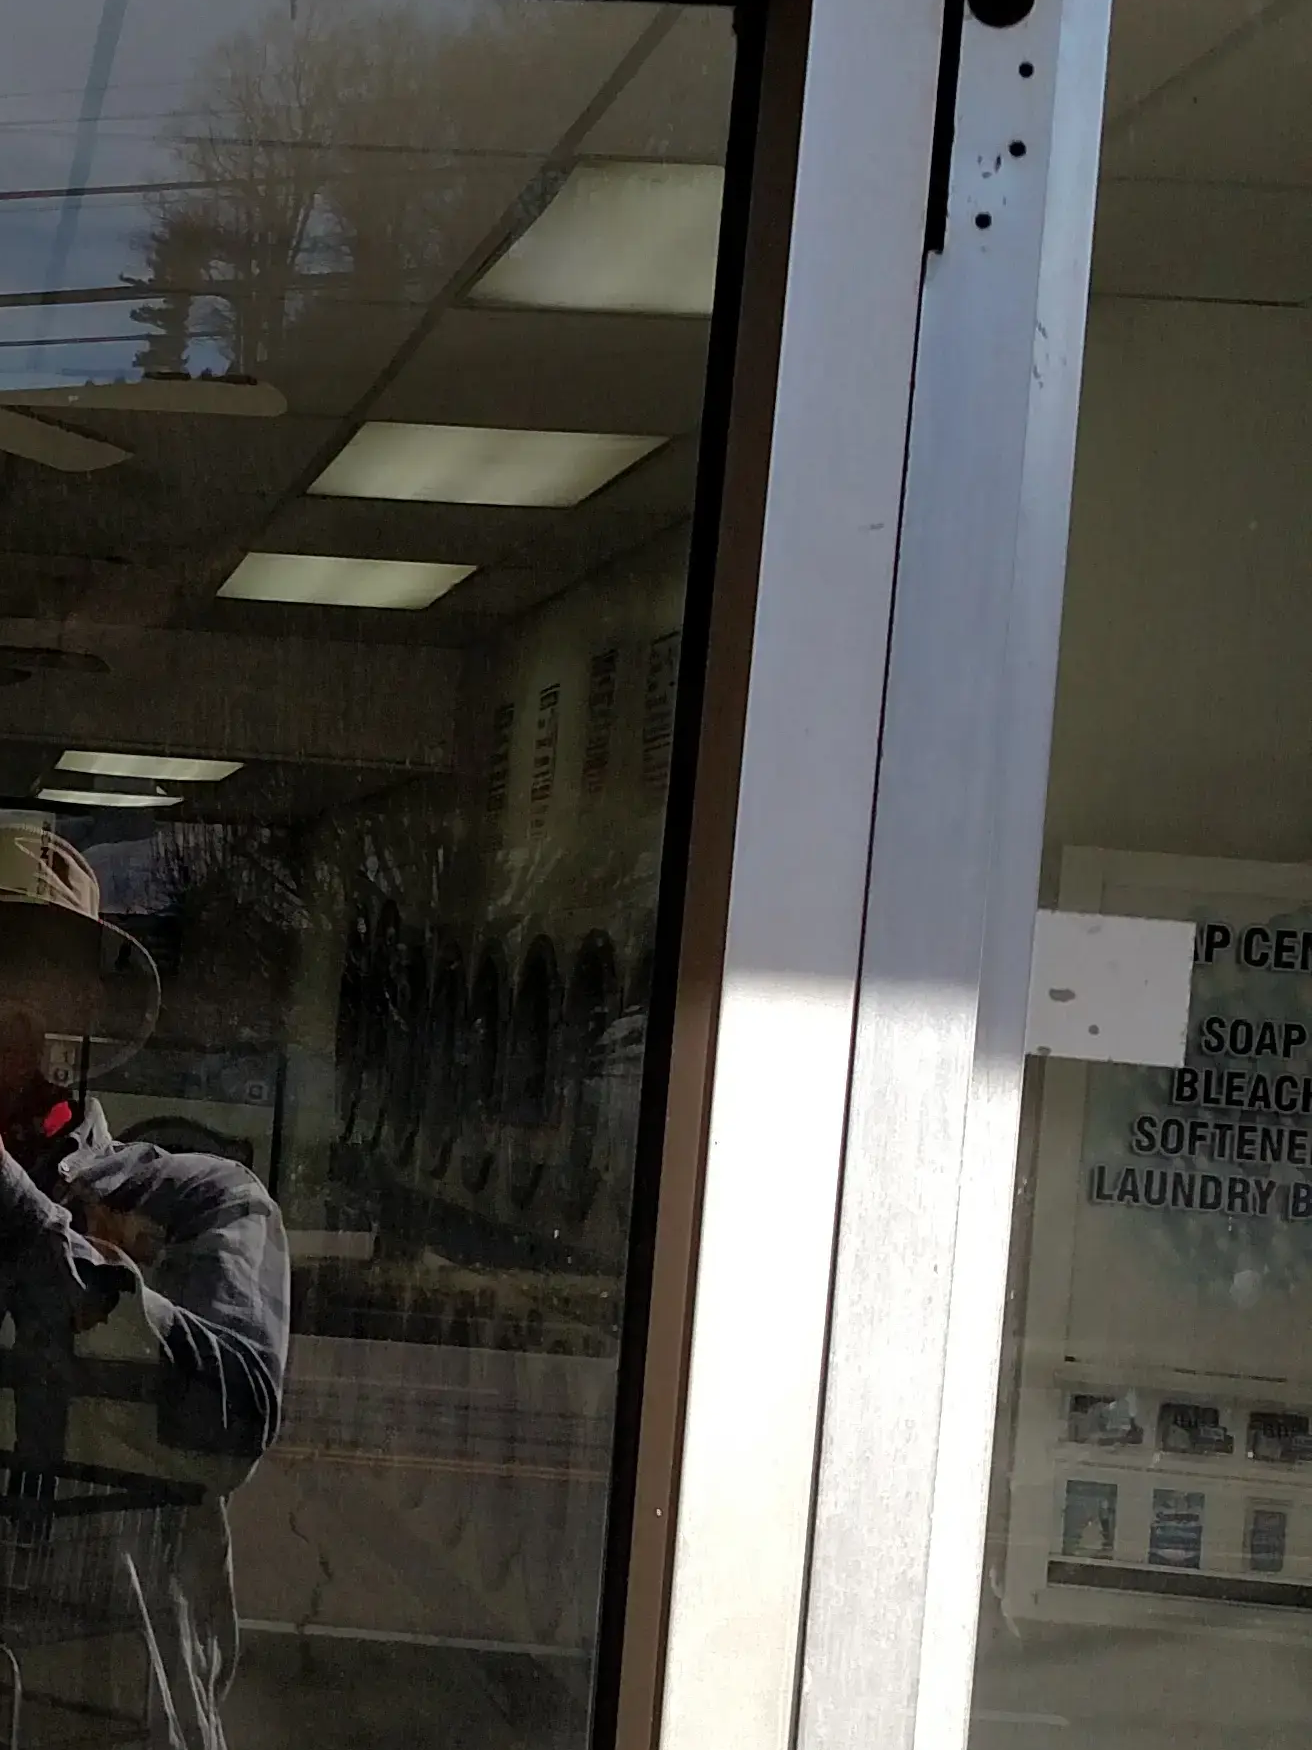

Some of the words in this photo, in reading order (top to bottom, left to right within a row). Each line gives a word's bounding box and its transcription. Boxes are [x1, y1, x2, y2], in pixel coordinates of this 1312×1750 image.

[1192, 923, 1231, 963] P
[1203, 1016, 1307, 1058] SOAP
[1133, 1115, 1312, 1164] SOFTENE
[1094, 1165, 1276, 1215] LAUNDRY
